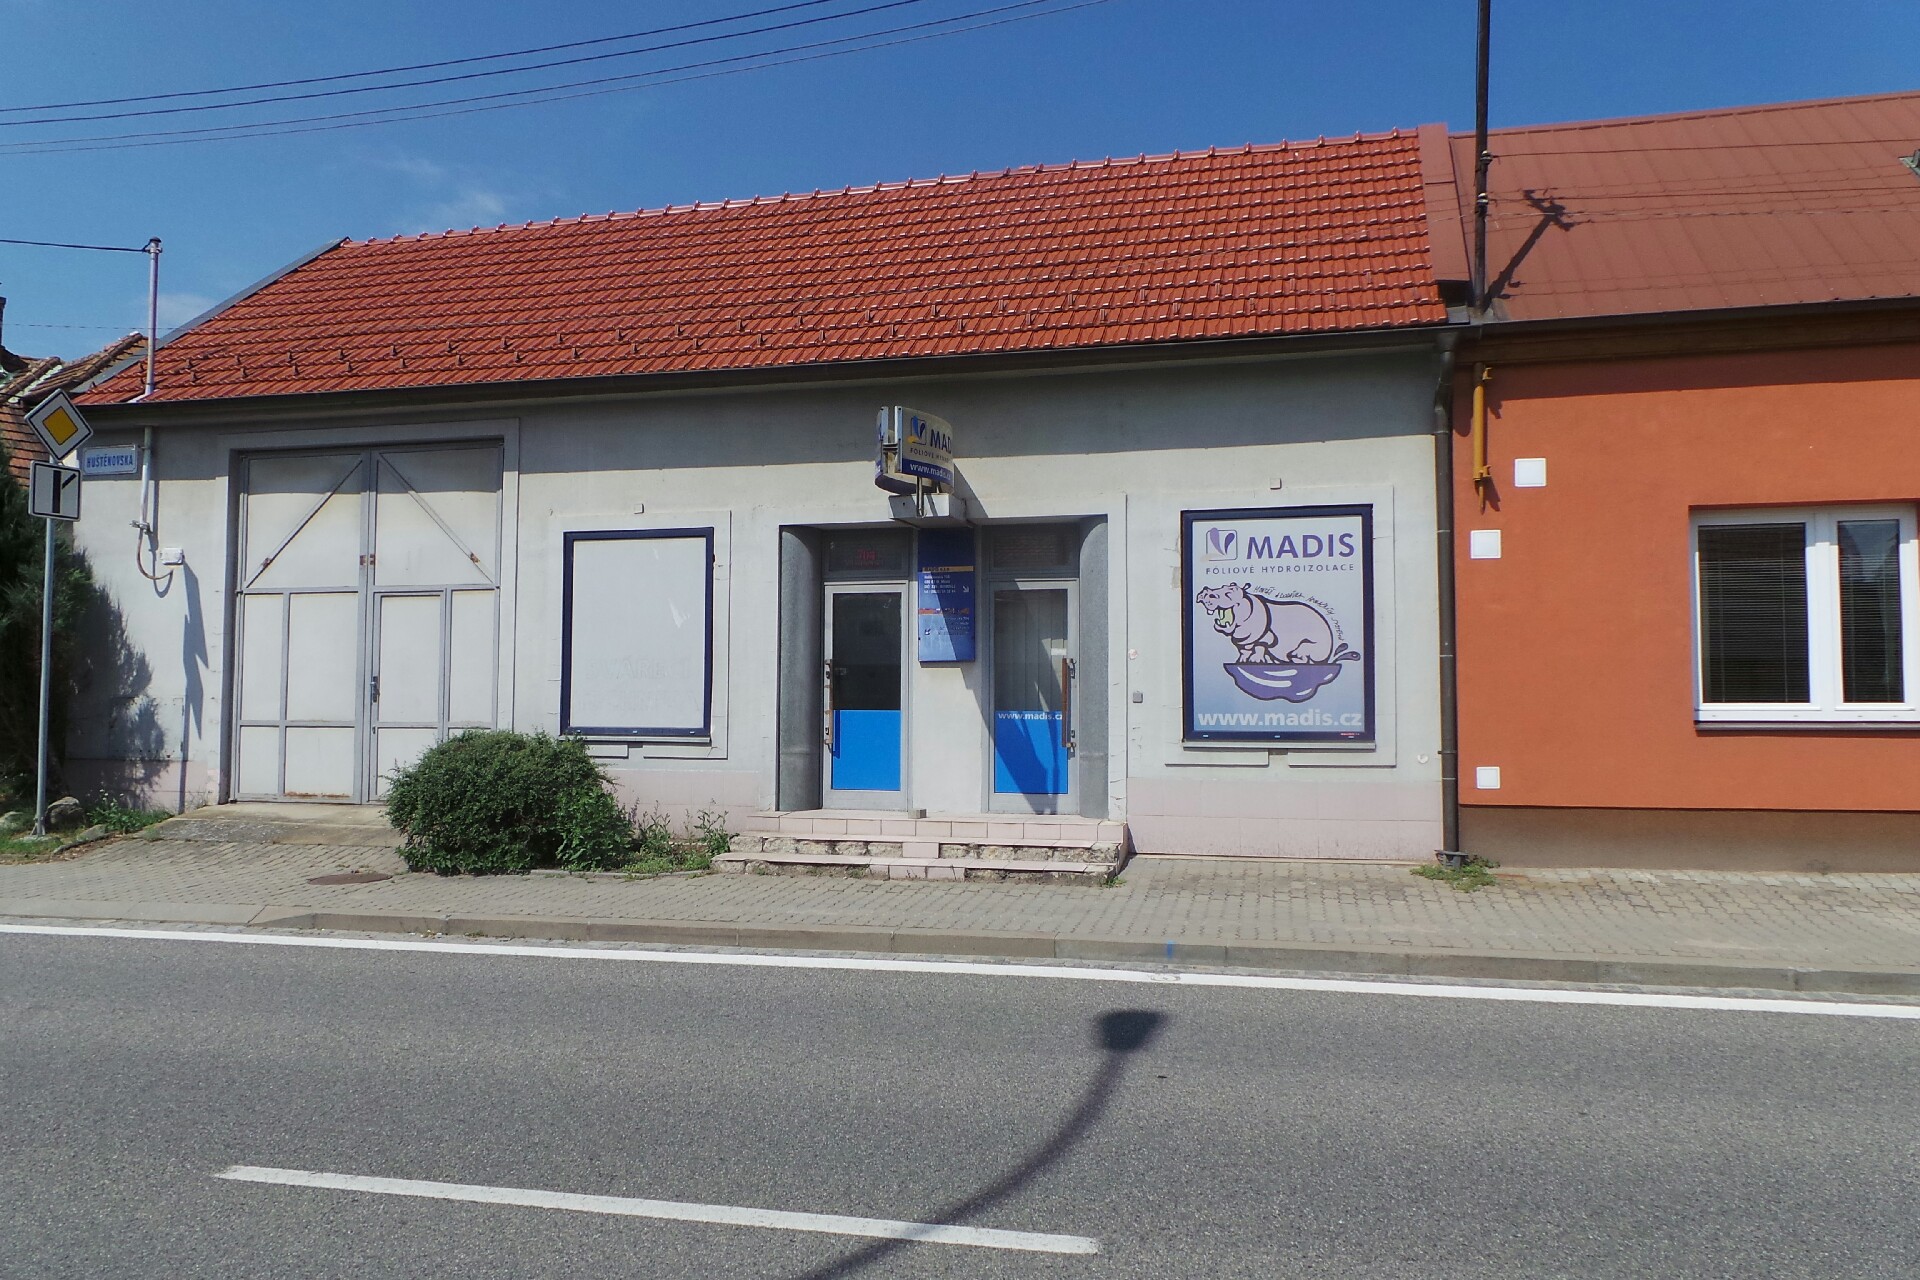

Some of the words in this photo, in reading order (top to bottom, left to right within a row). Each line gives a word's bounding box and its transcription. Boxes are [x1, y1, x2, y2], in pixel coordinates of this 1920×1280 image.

[1246, 533, 1355, 559] MADIS
[1261, 563, 1354, 574] HYDROIZOLACE
[1198, 708, 1362, 726] www.madis.cz
